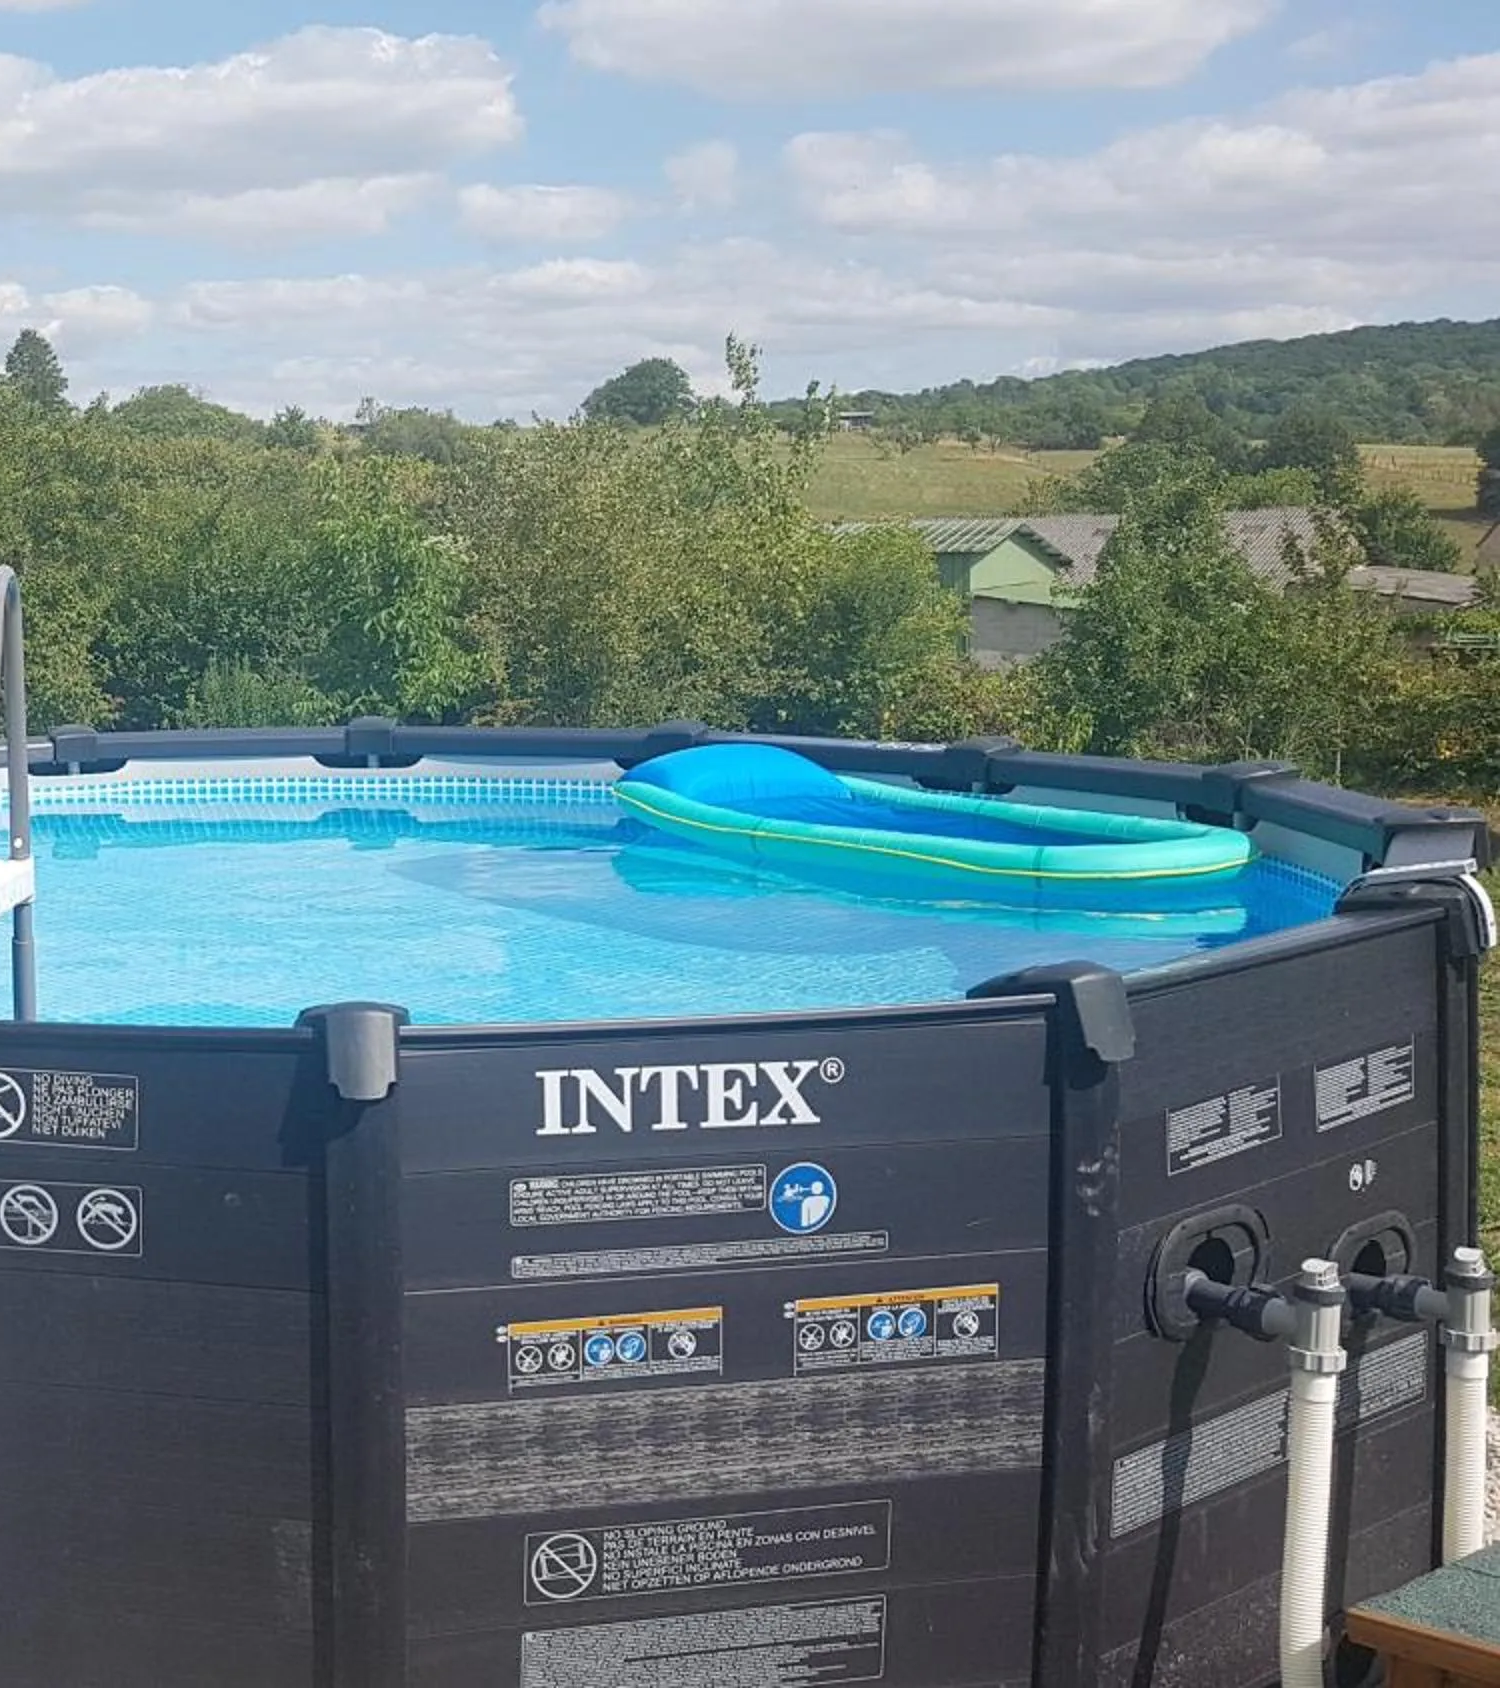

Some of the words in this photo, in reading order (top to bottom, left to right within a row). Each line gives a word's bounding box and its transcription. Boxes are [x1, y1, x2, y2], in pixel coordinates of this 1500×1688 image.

[33, 1074, 51, 1084] NO
[53, 1075, 94, 1087] DIVING
[33, 1083, 49, 1094] NE
[52, 1085, 75, 1095] PAS
[77, 1087, 135, 1100] PLONGER
[33, 1093, 51, 1103] NO
[70, 1106, 125, 1119] TAUCHEN
[61, 1126, 106, 1138] DUIKEN
[603, 1530, 621, 1541] NO
[623, 1525, 674, 1539] SLOPING
[677, 1520, 727, 1533] GROUND
[603, 1540, 625, 1550] PAS
[627, 1538, 645, 1548] DE
[647, 1533, 696, 1546] TERRAIN
[698, 1531, 715, 1541] EN
[717, 1527, 754, 1539] PENTE
[603, 1550, 621, 1560] NO
[623, 1545, 669, 1558] INSTALE
[671, 1544, 687, 1553] LA
[689, 1539, 734, 1552] PISCINA
[736, 1537, 753, 1547] EN
[755, 1533, 793, 1545] ZONAS
[795, 1530, 820, 1541] CON
[823, 1525, 877, 1538] DESNIVEL
[603, 1560, 631, 1571] KEIN
[603, 1580, 628, 1591] NIET
[631, 1574, 691, 1588] OPZETTEN
[694, 1572, 710, 1582] OP
[713, 1565, 780, 1580] AFLOPENDE
[782, 1557, 863, 1574] ONDERGROND
